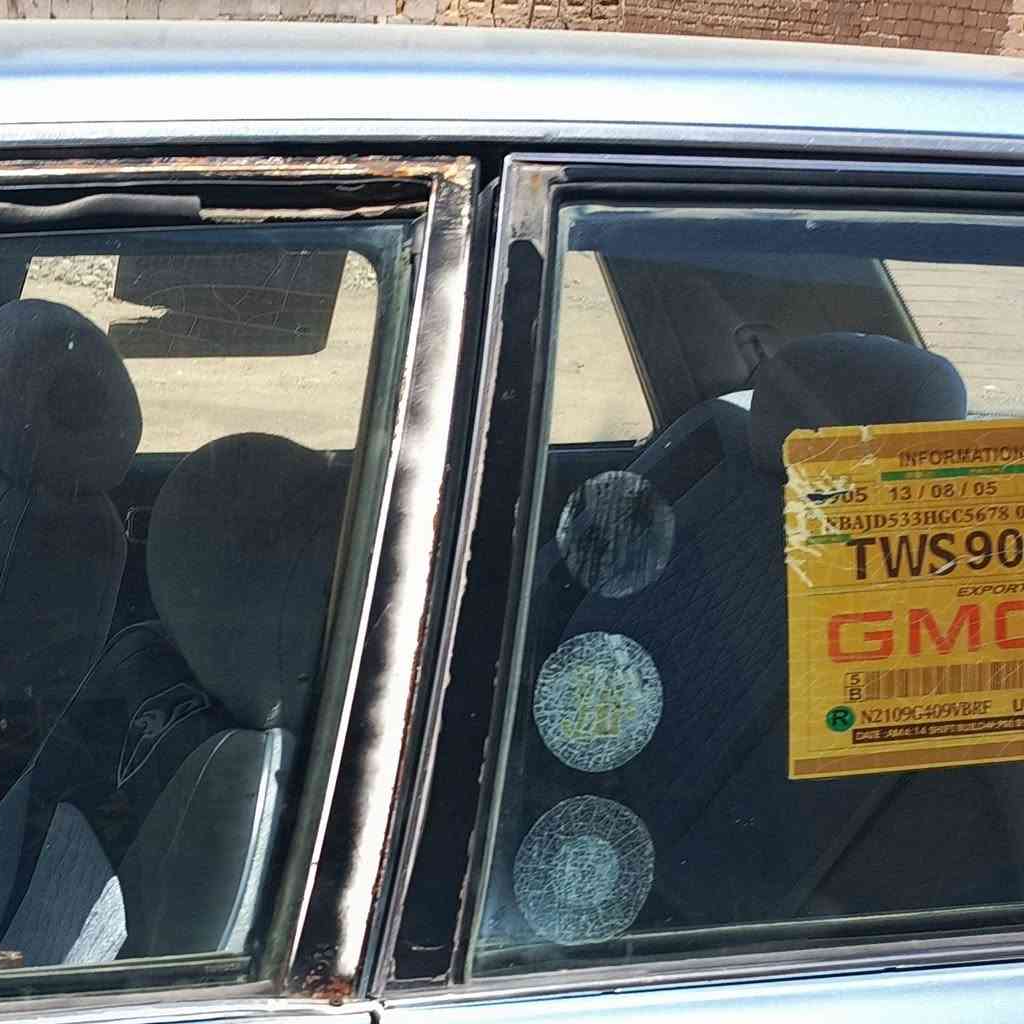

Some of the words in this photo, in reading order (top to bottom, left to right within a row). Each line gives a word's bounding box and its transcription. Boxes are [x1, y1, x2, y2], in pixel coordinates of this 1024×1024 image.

[889, 485, 912, 501] 13
[931, 482, 955, 498] 08
[974, 480, 998, 496] 05
